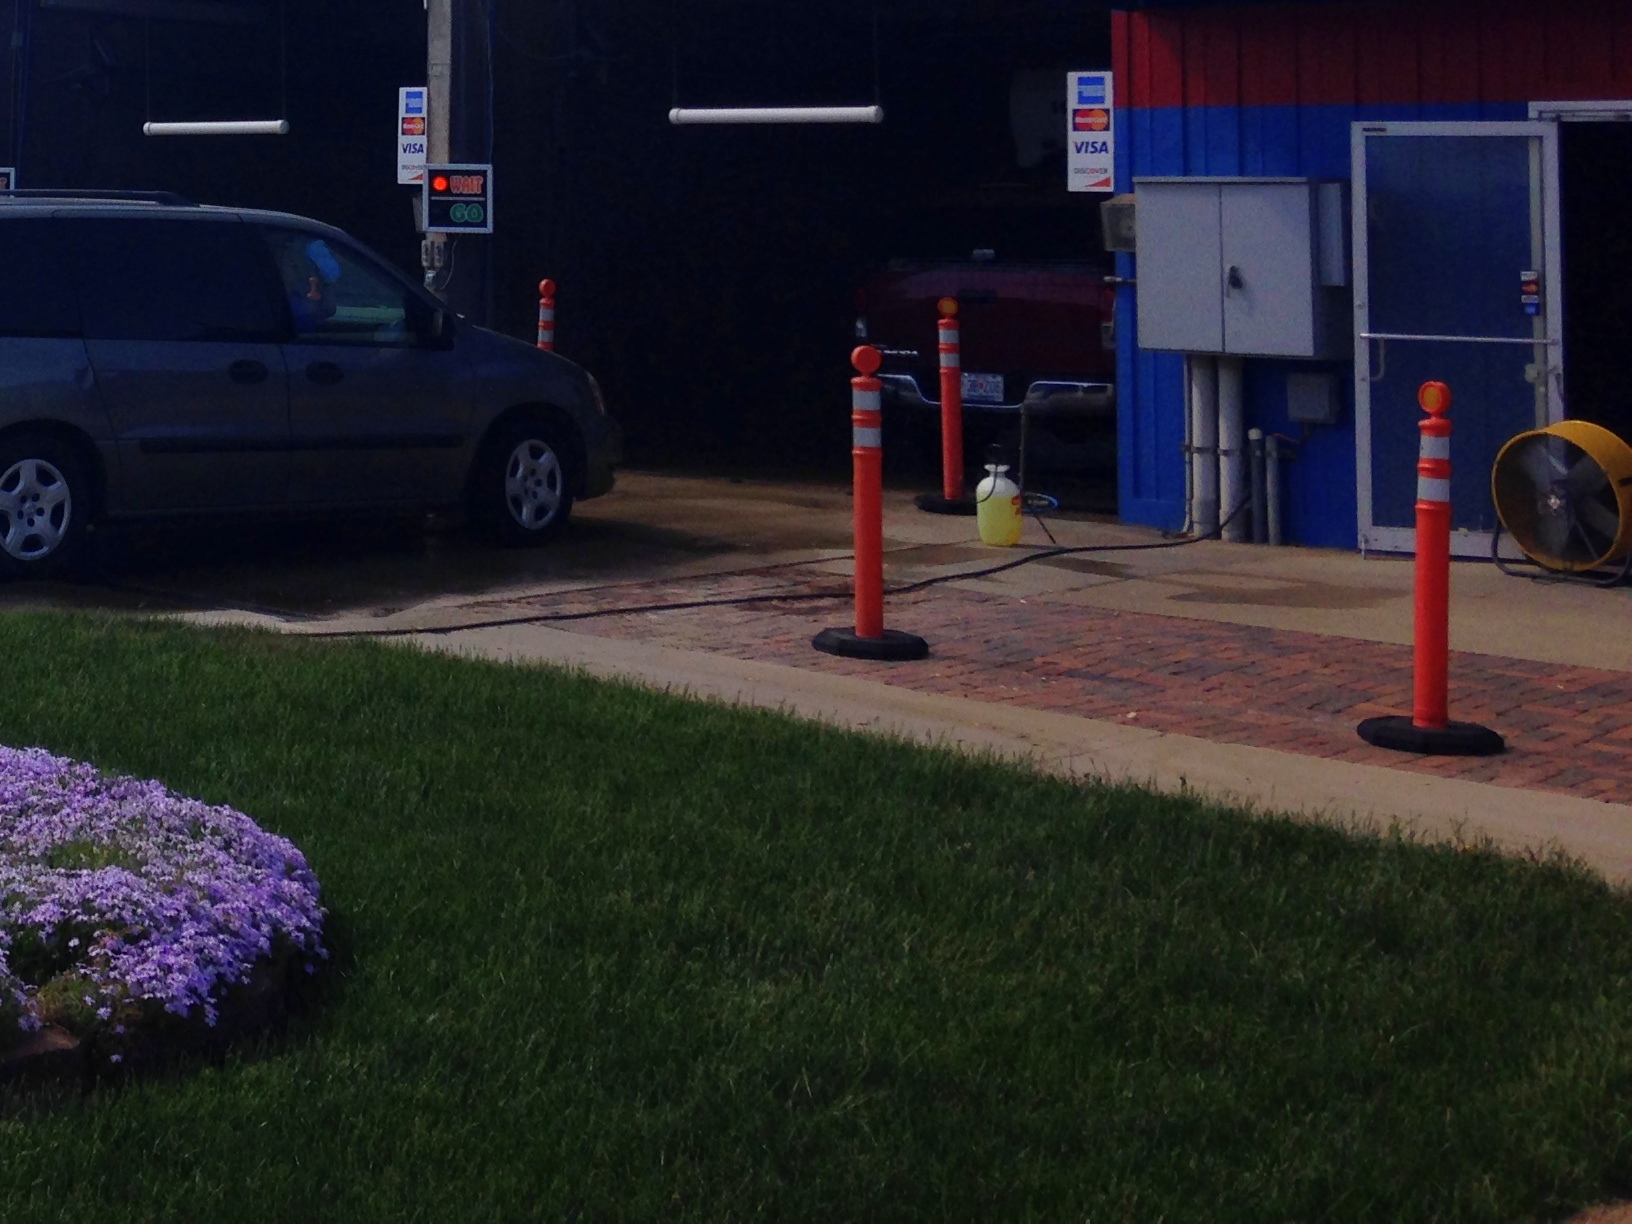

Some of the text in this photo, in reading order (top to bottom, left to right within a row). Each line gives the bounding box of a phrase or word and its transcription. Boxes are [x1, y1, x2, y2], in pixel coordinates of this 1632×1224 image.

[402, 143, 424, 154] VISA
[1074, 142, 1109, 154] VISA
[450, 176, 484, 194] WAIT
[450, 203, 484, 223] GO
